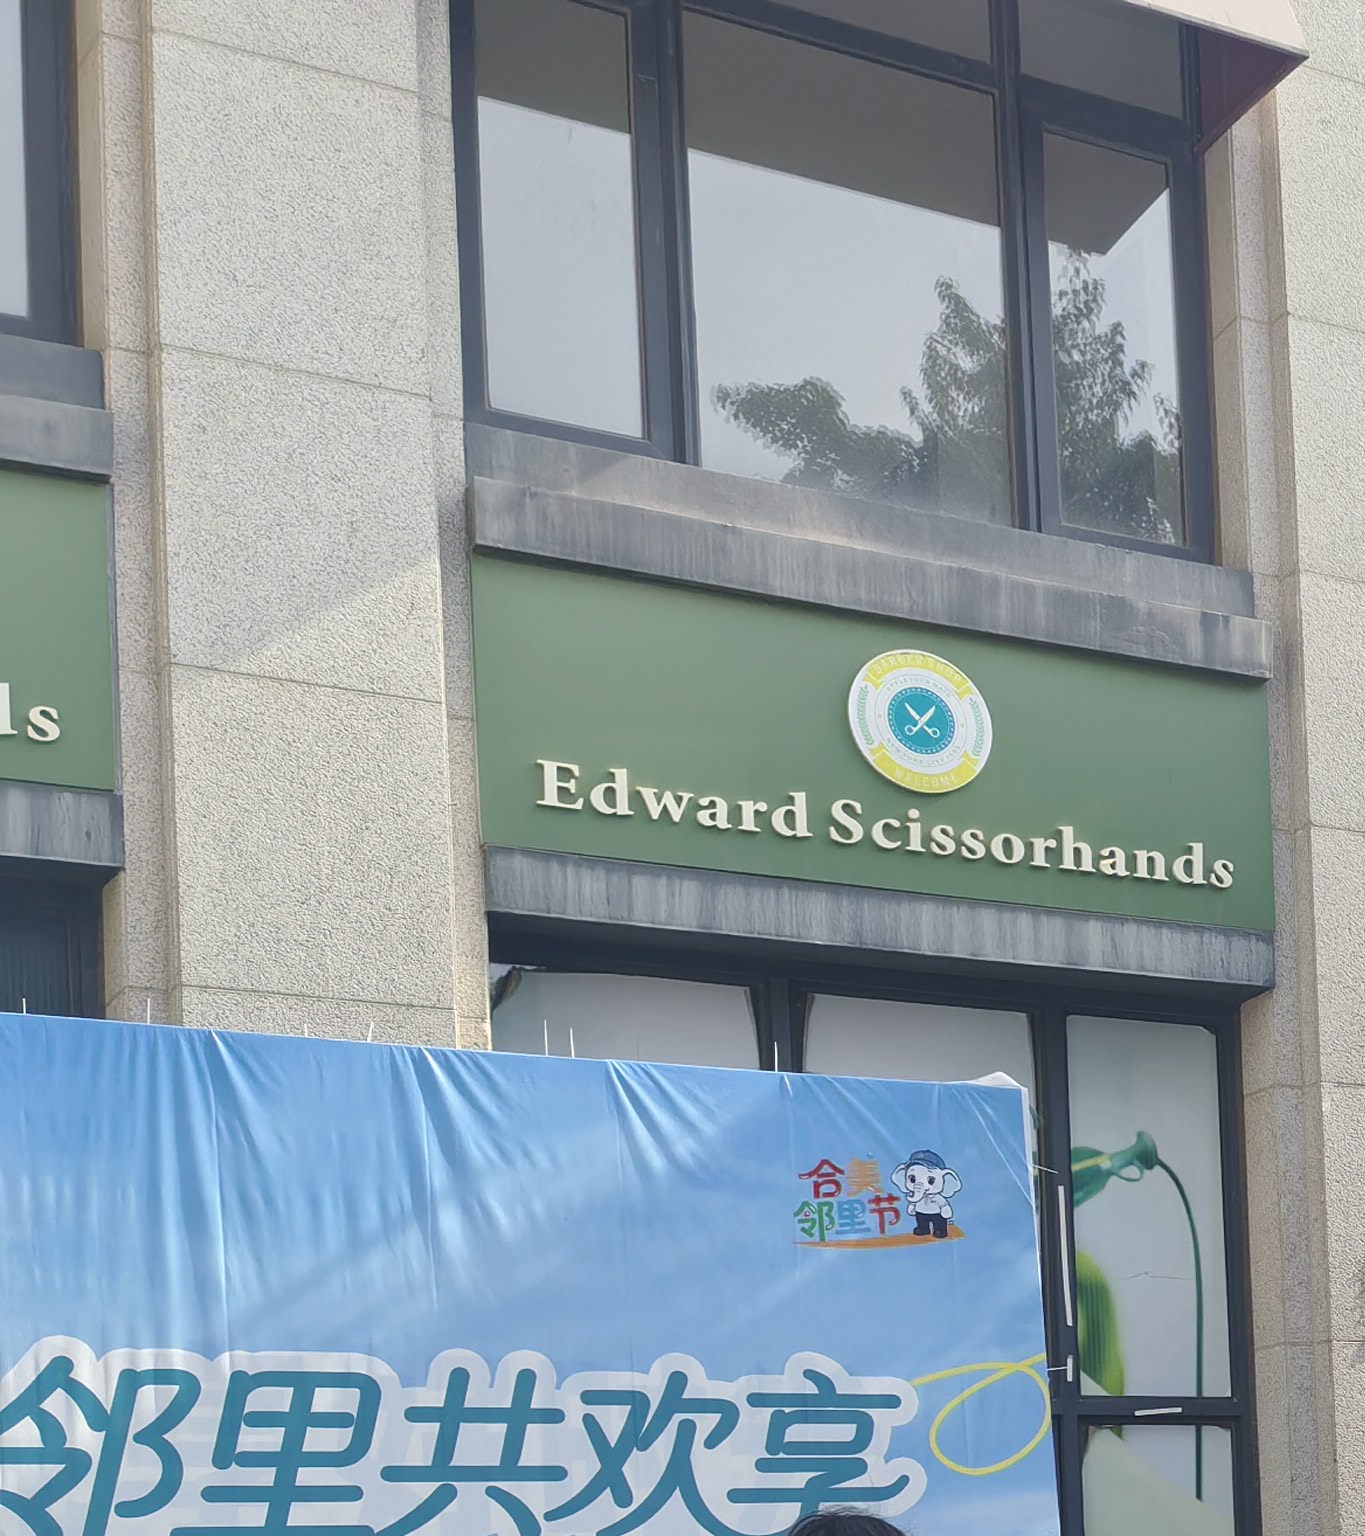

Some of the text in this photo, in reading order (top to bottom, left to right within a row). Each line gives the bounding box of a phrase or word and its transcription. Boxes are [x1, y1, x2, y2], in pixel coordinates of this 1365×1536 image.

[536, 759, 1235, 889] Edward Scissorhands
[798, 1157, 884, 1199] 合美
[793, 1194, 901, 1242] 邻里节
